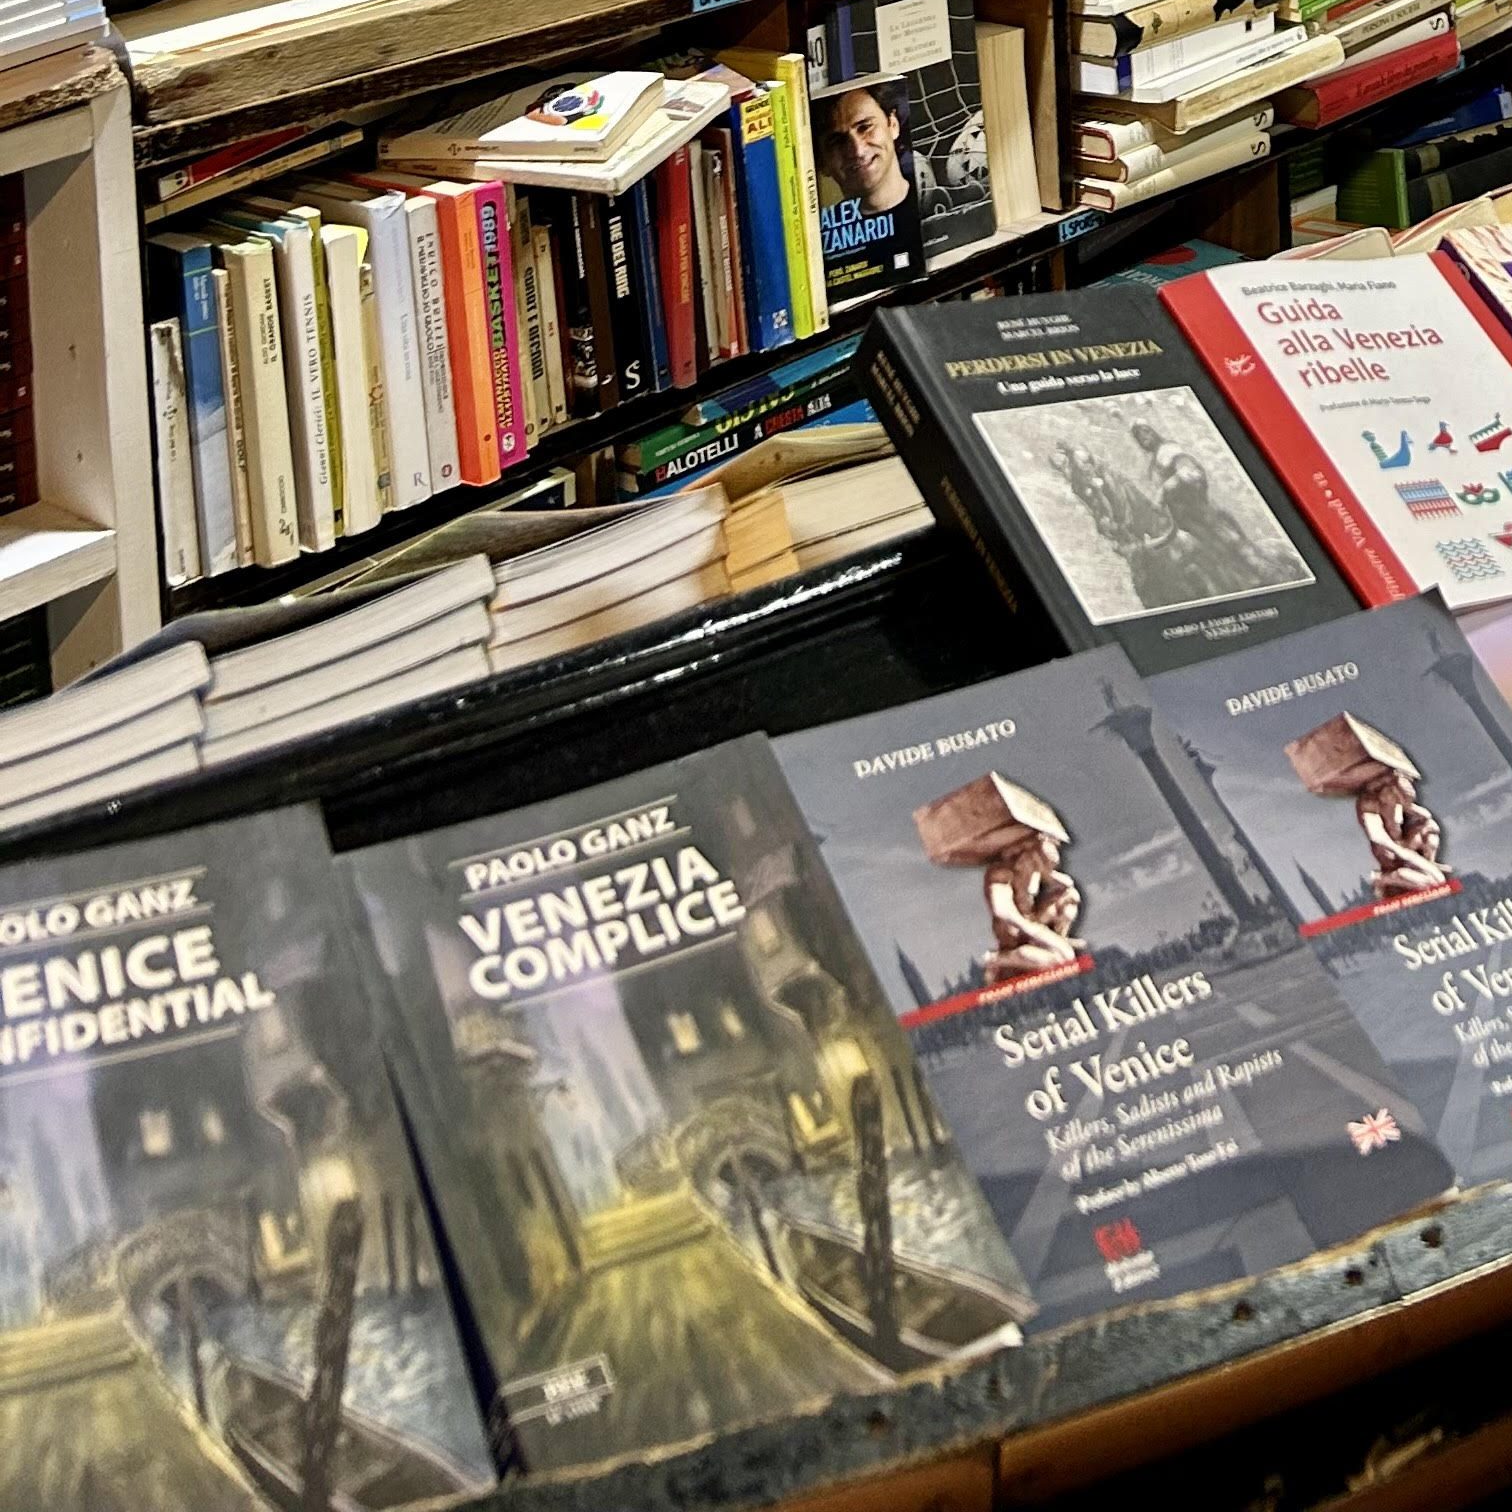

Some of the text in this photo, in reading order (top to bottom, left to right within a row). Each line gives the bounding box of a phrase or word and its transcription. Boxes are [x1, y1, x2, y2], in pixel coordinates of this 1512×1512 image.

[821, 198, 863, 230] ALEX
[822, 213, 894, 254] ZANARDI
[1241, 283, 1288, 296] Beatrice
[1337, 281, 1367, 292] Maria
[1257, 298, 1343, 324] Guida
[303, 293, 317, 342] TENNIS
[1279, 324, 1444, 356] alla Venezia
[946, 339, 1163, 379] PERDERSI IN VENEZIA
[1028, 375, 1065, 394] guida
[1065, 372, 1100, 387] verso
[1298, 357, 1390, 388] ribelle
[655, 433, 739, 484] BALOTELLI
[1226, 662, 1359, 716] DAVIDE BUSATO
[853, 719, 1017, 778] DAVIDE BUSATO
[465, 804, 677, 890] PAOLO GANZ
[84, 881, 198, 928] GANZ
[457, 845, 721, 955] VENEZIA
[467, 882, 747, 1001] COMPLICE
[1394, 923, 1478, 972] Serial
[0, 926, 222, 1019] ENICE
[1431, 974, 1467, 1016] of
[995, 969, 1213, 1069] Serial Killers
[1025, 1035, 1195, 1121] of Venice
[1472, 1043, 1488, 1069] of
[1044, 1045, 1283, 1156] Killers, Sadists and Rapists
[1060, 1104, 1224, 1183] of the Serenissima
